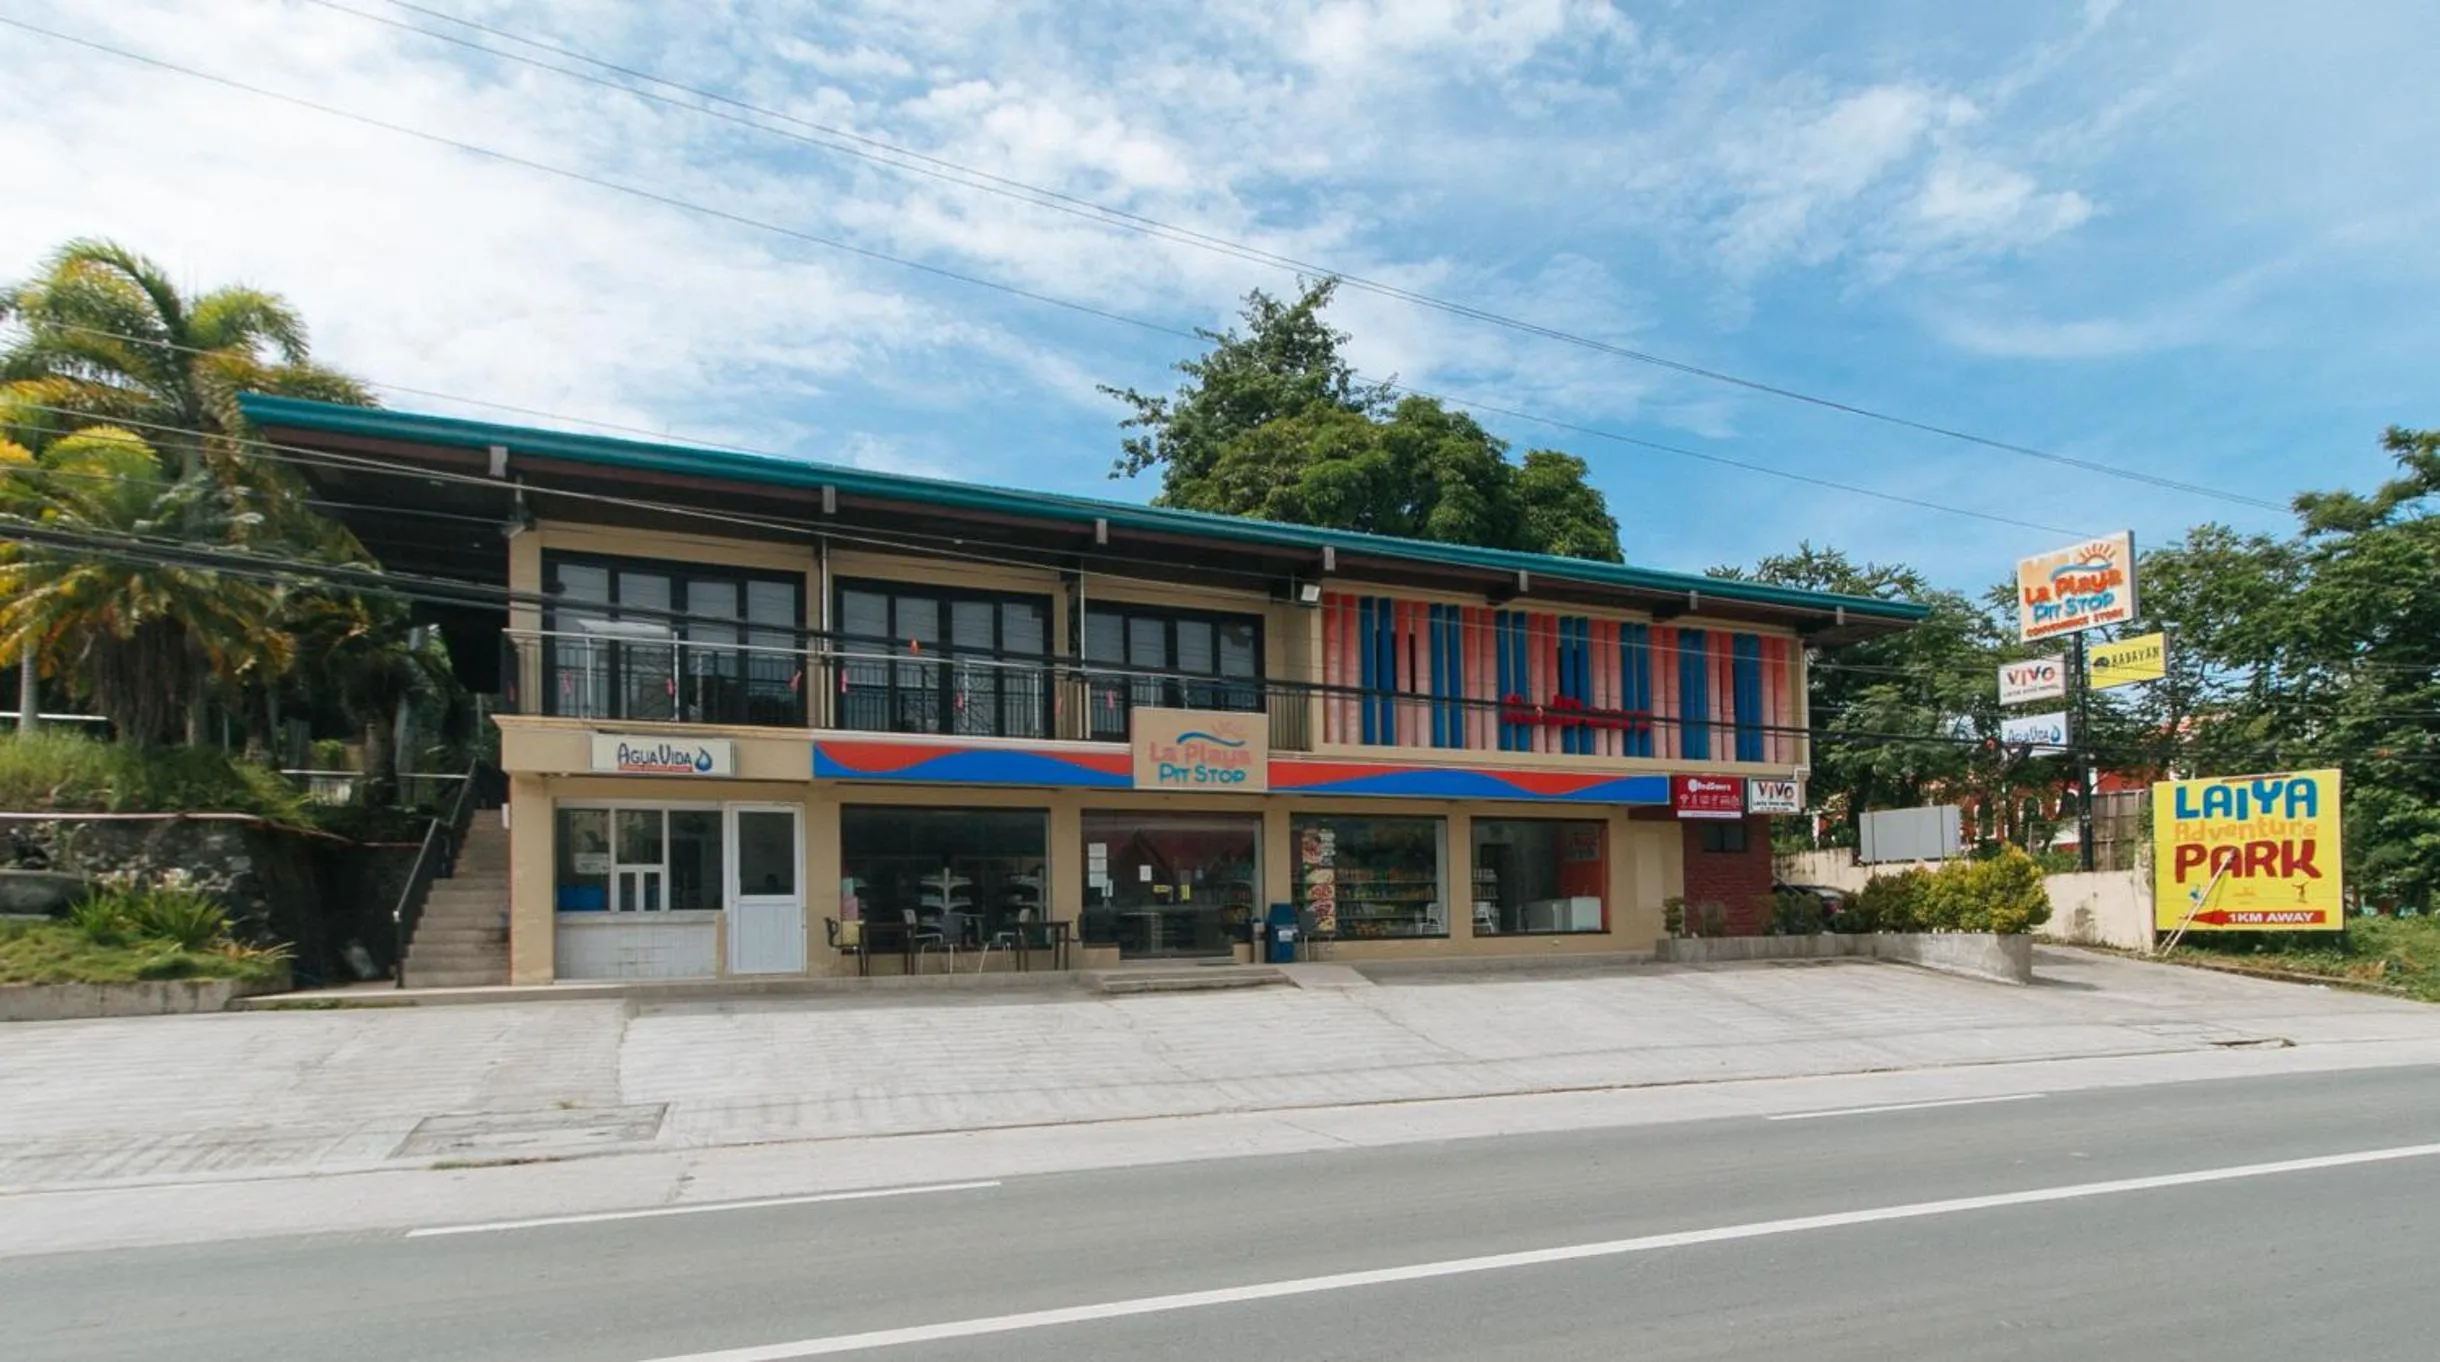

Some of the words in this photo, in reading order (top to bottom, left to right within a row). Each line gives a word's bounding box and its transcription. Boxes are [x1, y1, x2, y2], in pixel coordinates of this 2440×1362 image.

[2024, 586, 2050, 606] La
[2055, 569, 2123, 598] Playa
[2065, 592, 2115, 616] STOP
[2006, 666, 2056, 686] VIVO
[1150, 741, 1178, 763] La
[1186, 743, 1252, 767] Playa
[1194, 764, 1247, 784] STOP
[1758, 781, 1795, 800] VIVO
[2175, 778, 2318, 821] LAIYA
[2174, 817, 2317, 843] Adventure
[2175, 839, 2322, 884] PARK
[2229, 912, 2264, 923] 1KM
[2266, 911, 2314, 922] AWAY
